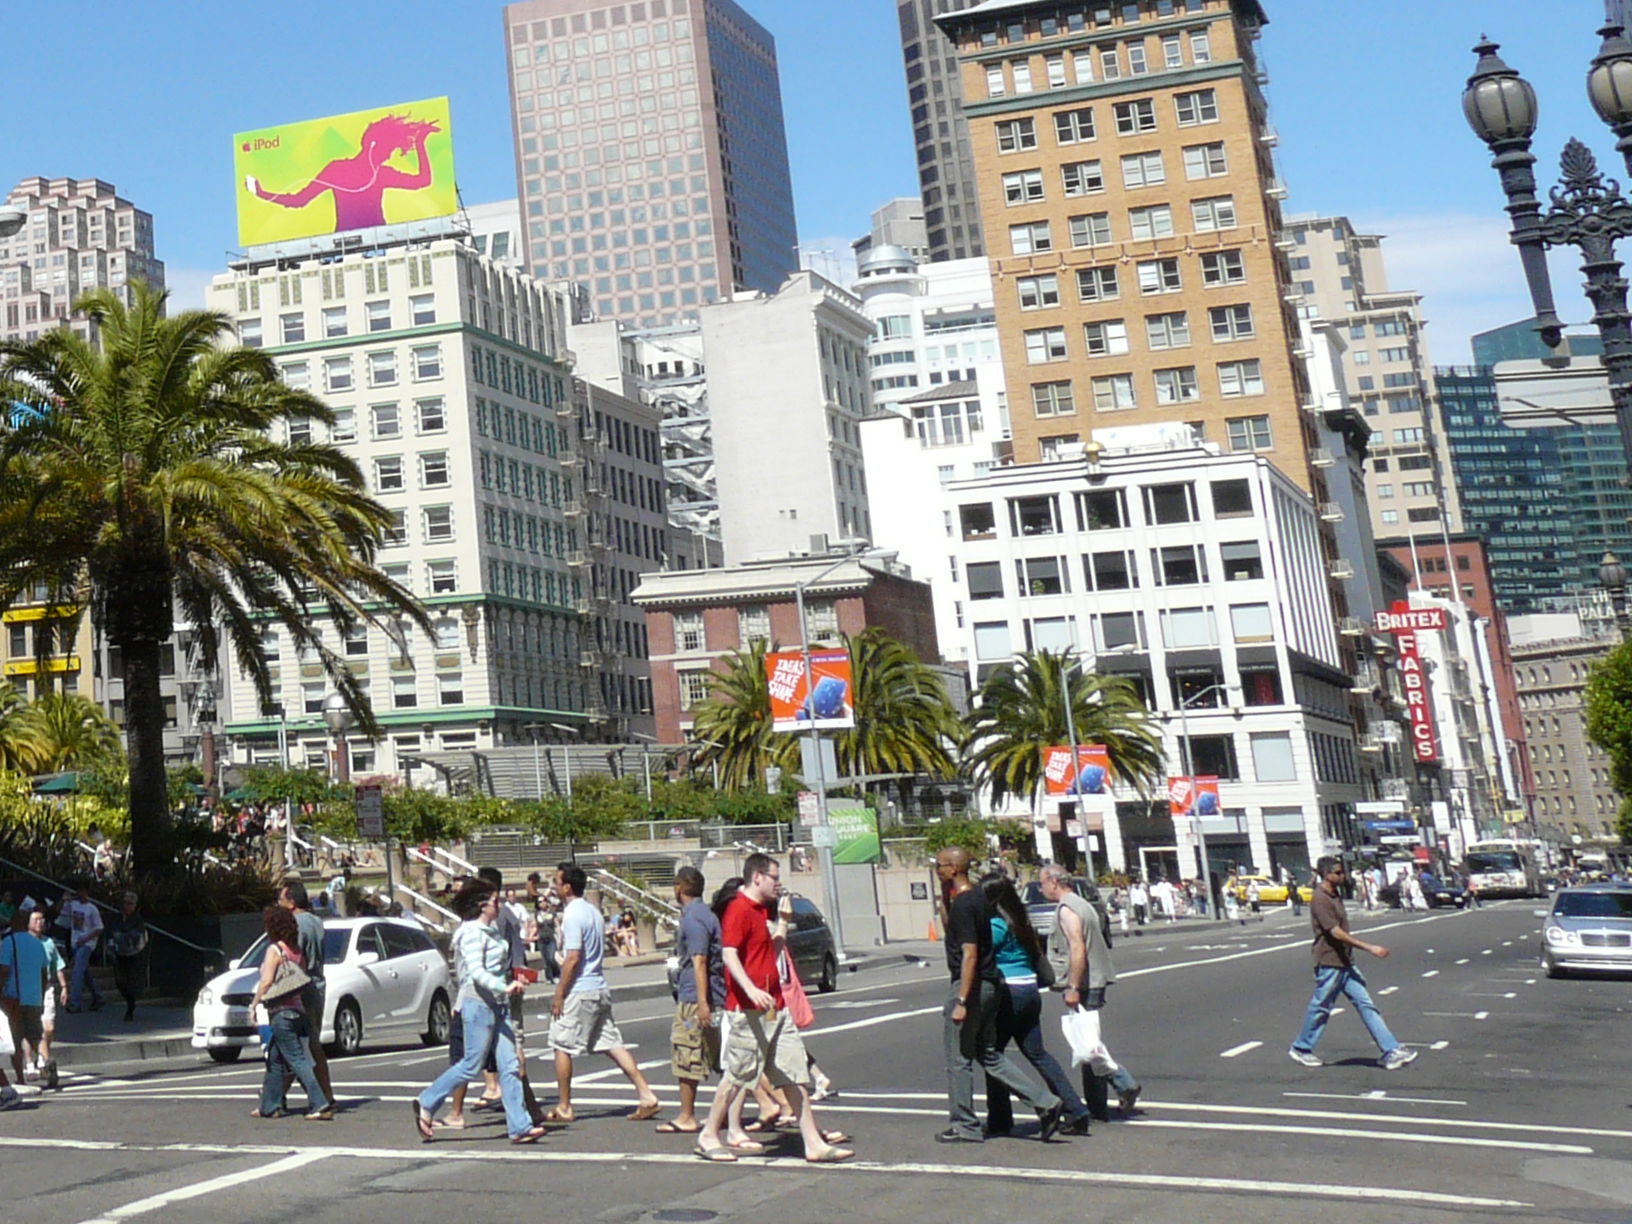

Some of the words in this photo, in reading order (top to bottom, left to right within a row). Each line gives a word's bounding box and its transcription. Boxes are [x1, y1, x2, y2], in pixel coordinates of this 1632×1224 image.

[254, 135, 280, 151] iPod
[1376, 612, 1442, 631] BRITEX
[774, 671, 800, 687] TAKE
[1398, 635, 1433, 756] FABRICS
[836, 824, 870, 833] QUARE
